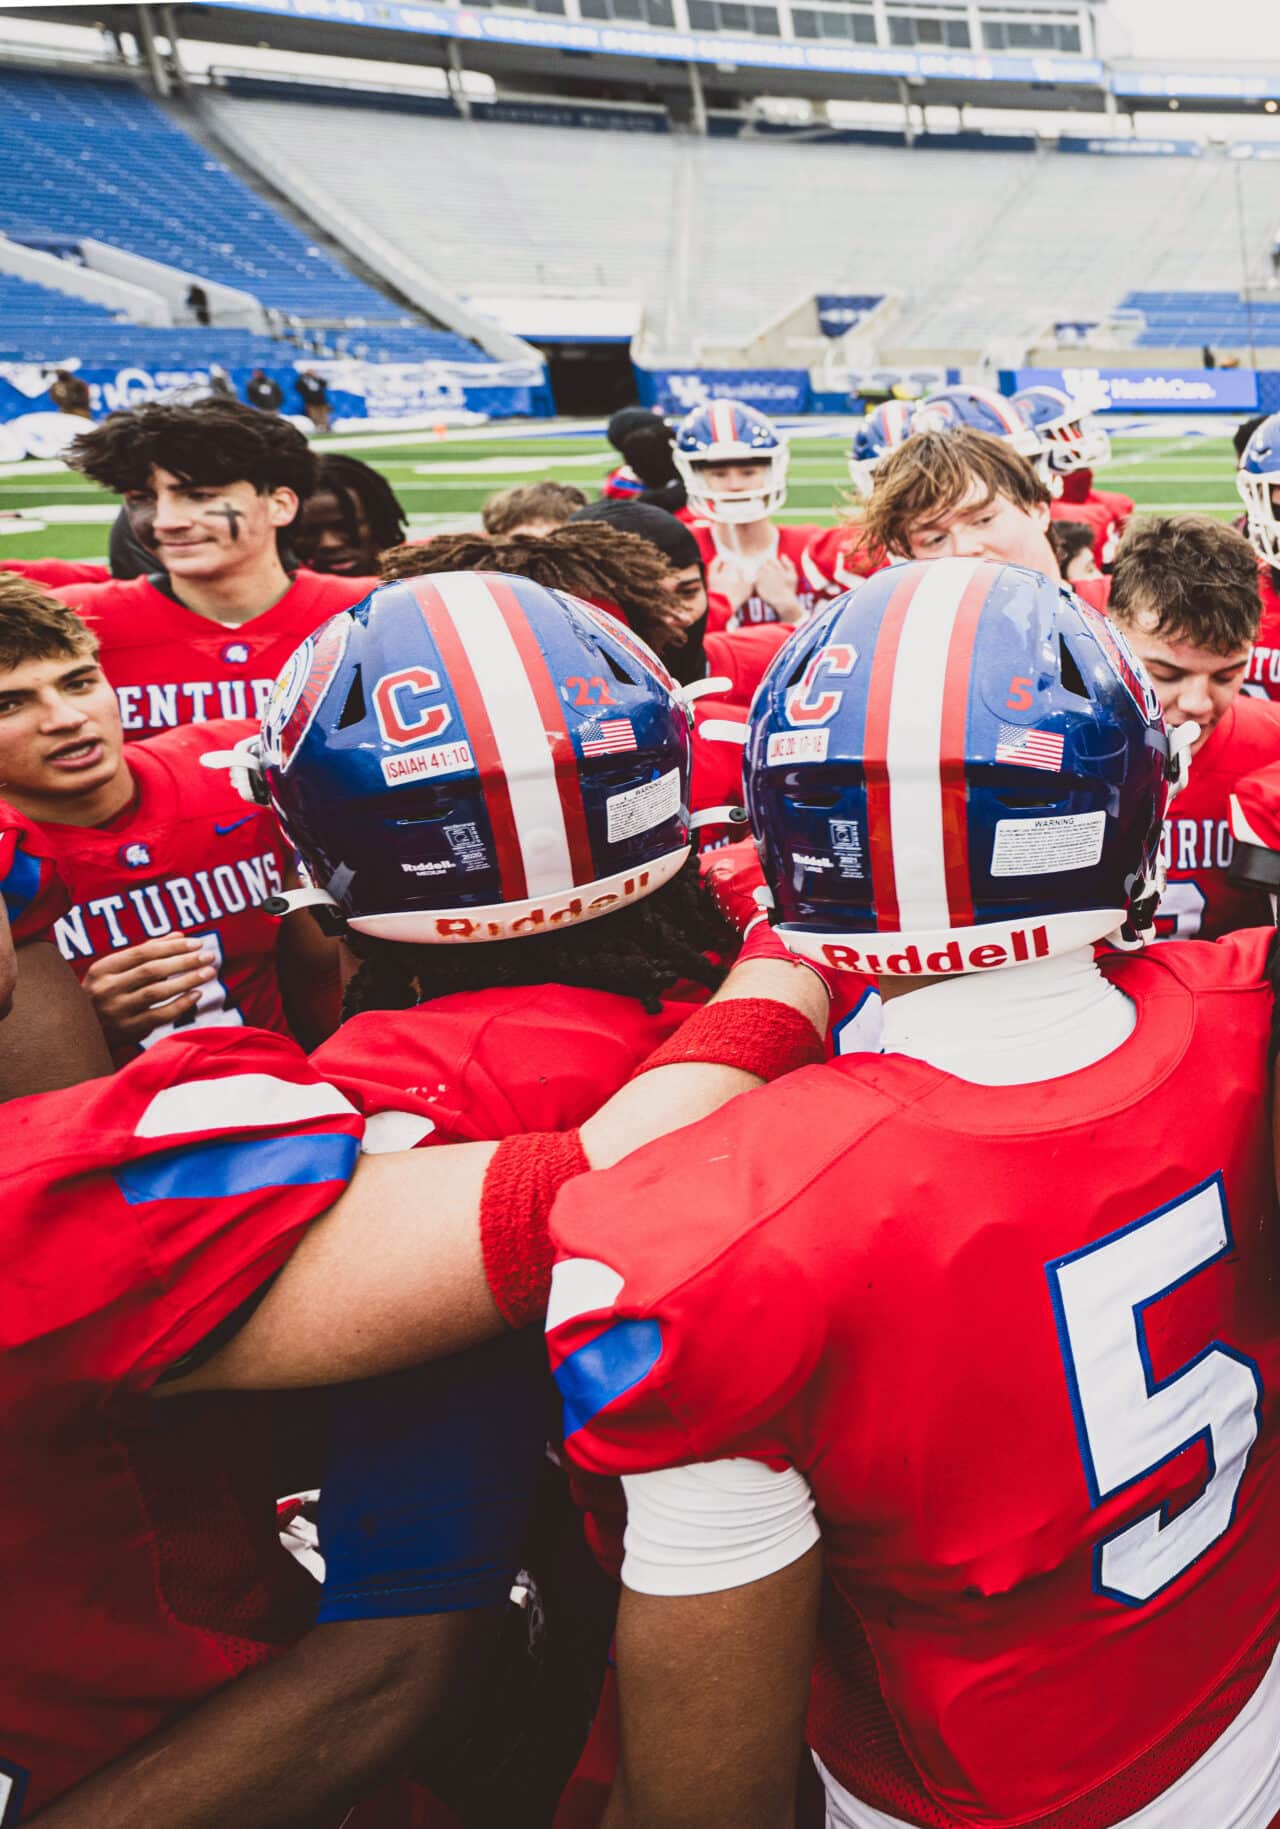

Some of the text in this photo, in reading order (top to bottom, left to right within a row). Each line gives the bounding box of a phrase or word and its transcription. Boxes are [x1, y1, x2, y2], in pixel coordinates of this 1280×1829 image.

[372, 666, 452, 747] C
[565, 676, 617, 706] 22
[785, 643, 858, 727] C
[1005, 676, 1034, 711] 5
[386, 746, 470, 779] ISAIAH 41:10
[1035, 817, 1075, 827] WARNING
[53, 852, 284, 961] NTURIONS
[435, 871, 649, 937] Riddell
[821, 925, 1050, 976] Riddell
[1044, 1169, 1264, 1609] 5
